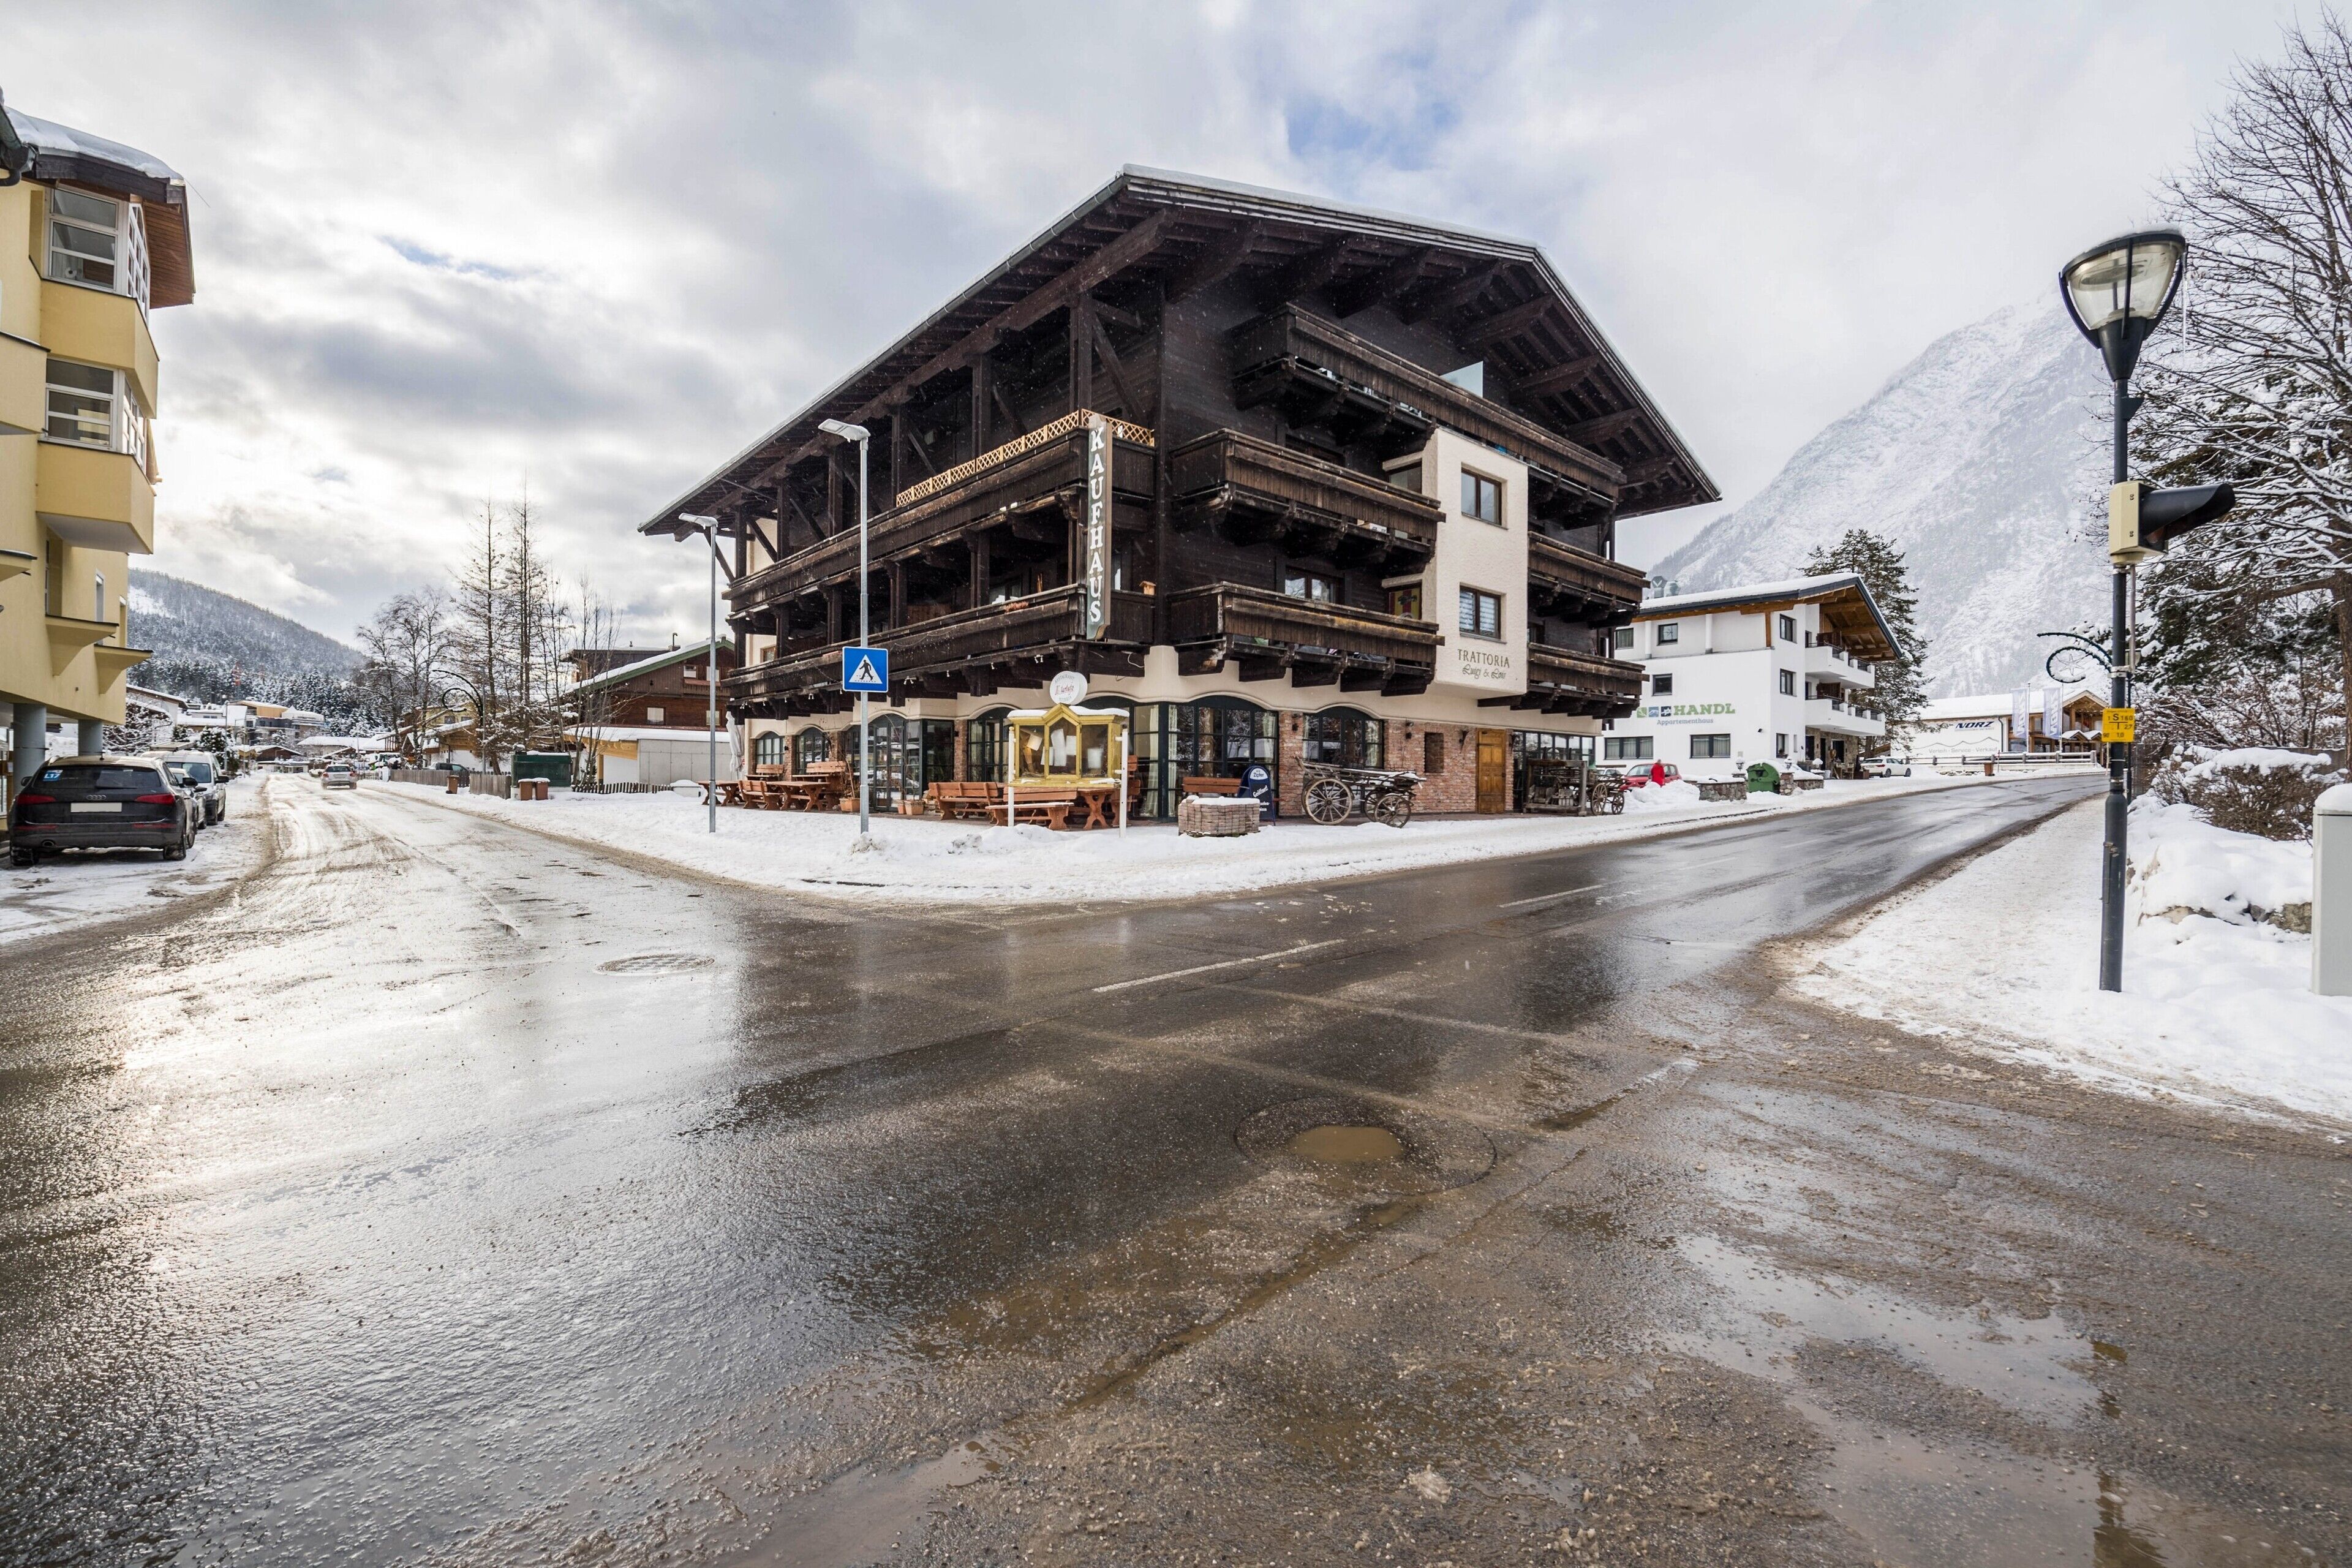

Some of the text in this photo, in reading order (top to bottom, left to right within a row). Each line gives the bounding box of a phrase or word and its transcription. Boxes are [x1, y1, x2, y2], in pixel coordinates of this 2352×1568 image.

[1089, 427, 1104, 623] KAUFHAUS
[1458, 649, 1510, 668] TRATTORIA
[1673, 704, 1735, 715] HANDL
